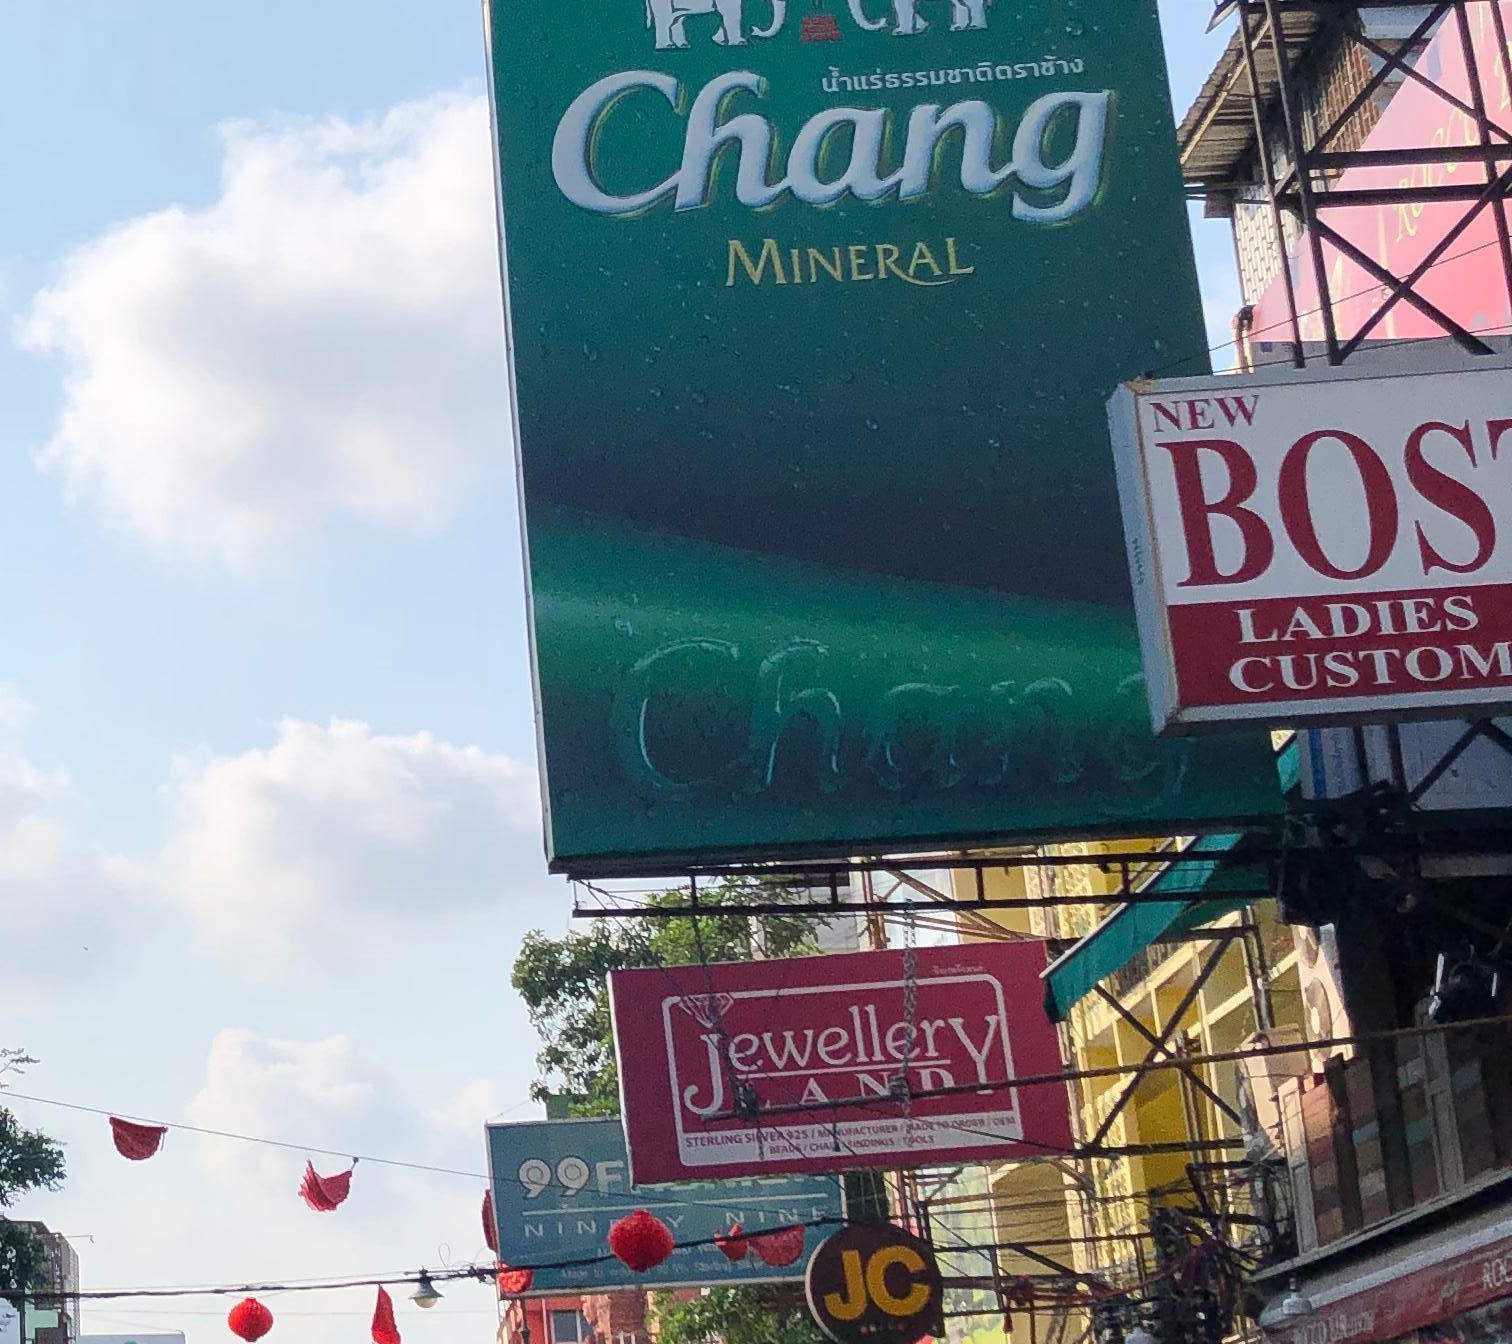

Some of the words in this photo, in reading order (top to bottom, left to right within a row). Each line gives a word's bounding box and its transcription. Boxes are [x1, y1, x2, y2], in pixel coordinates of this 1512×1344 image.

[551, 69, 1118, 226] Chang
[1149, 394, 1260, 433] NEW
[1234, 595, 1479, 644] LADIES
[685, 1133, 743, 1149] STERLING
[823, 1244, 932, 1321] JC
